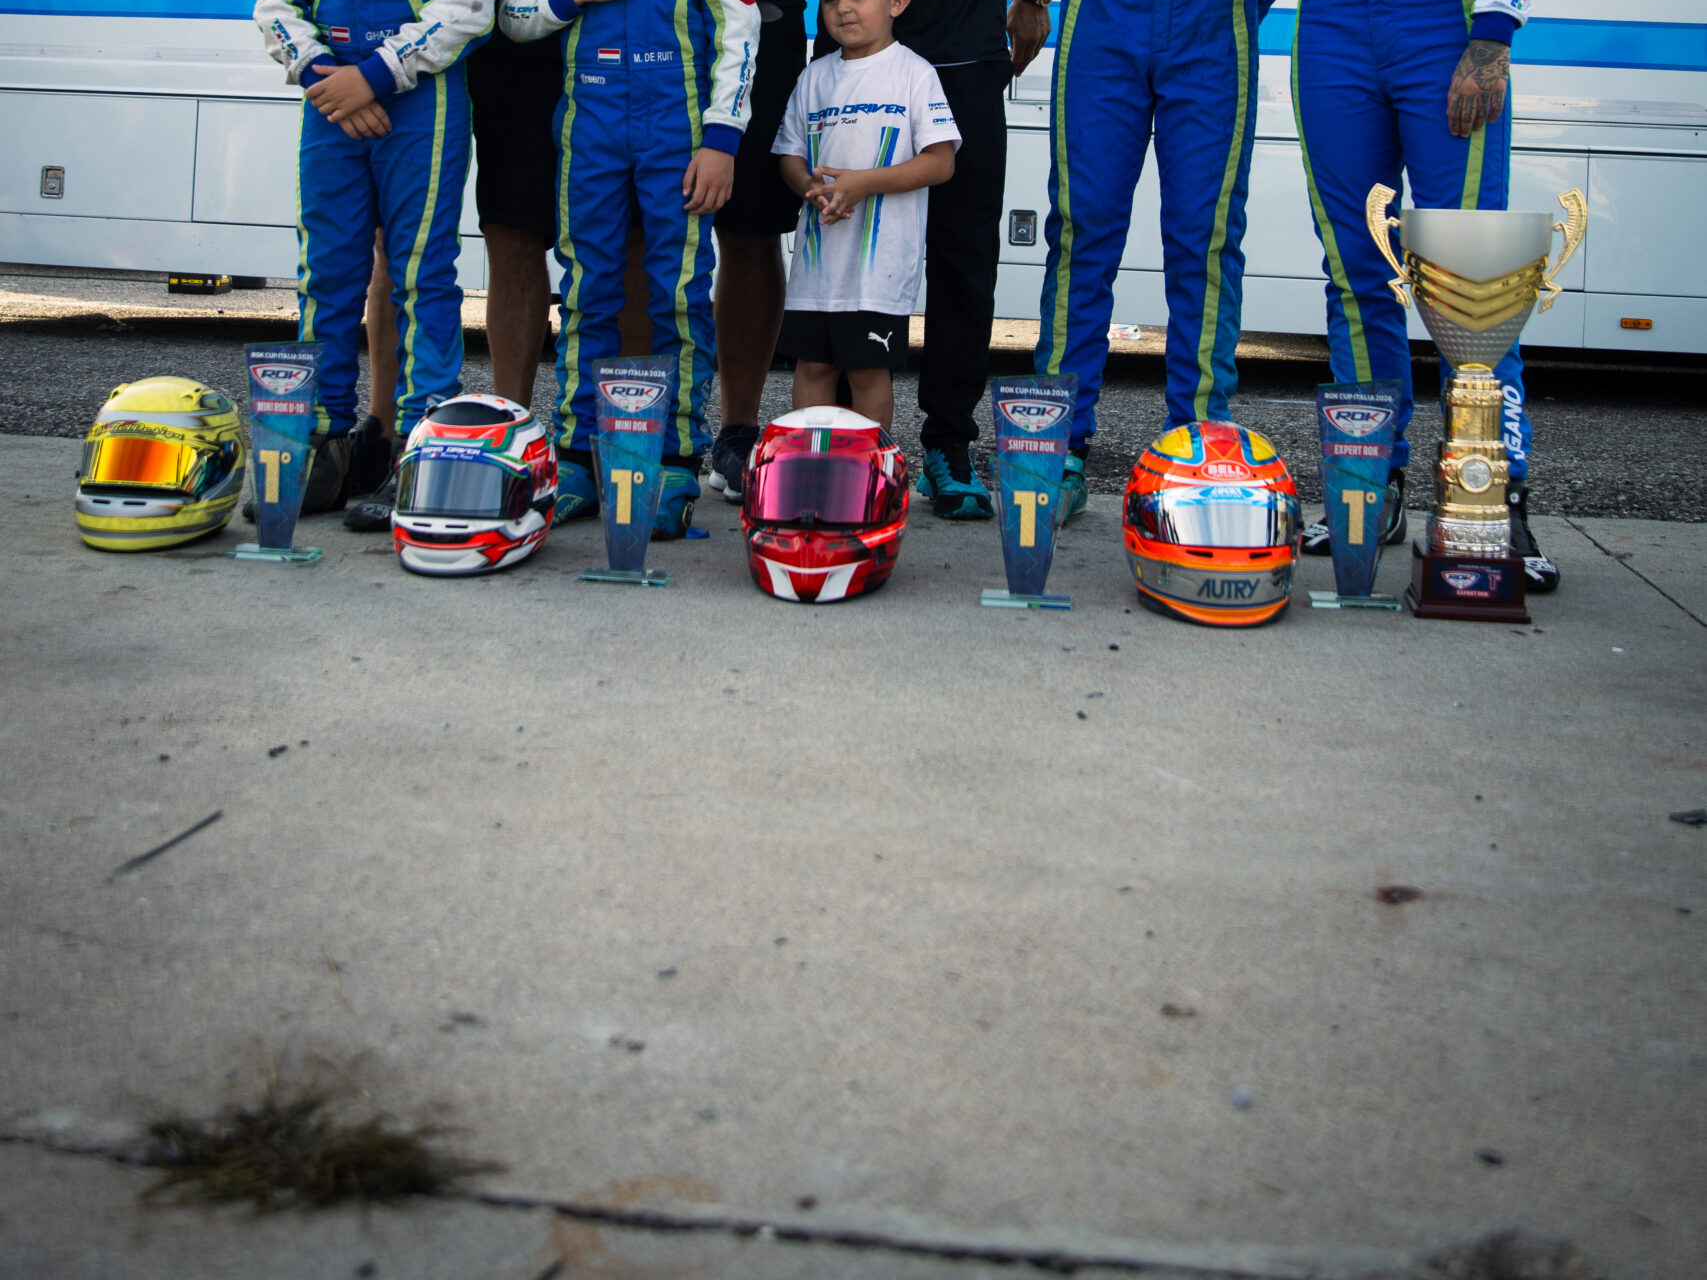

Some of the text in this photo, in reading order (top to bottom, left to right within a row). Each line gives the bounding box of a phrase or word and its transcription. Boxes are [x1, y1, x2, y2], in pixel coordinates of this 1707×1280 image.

[633, 51, 674, 63] M. DE RUIT
[841, 103, 906, 118] DRIVER
[251, 351, 265, 359] ROK
[261, 369, 303, 380] ROK
[600, 367, 614, 375] ROK
[611, 386, 655, 397] ROK
[1000, 386, 1015, 394] ROK
[257, 401, 274, 412] MINI
[274, 402, 288, 412] ROK
[1010, 405, 1056, 416] ROK
[1335, 411, 1380, 421] ROK
[615, 419, 648, 431] MINI ROK
[1008, 438, 1055, 453] SHIFTER ROK
[1334, 444, 1378, 457] EXPERT ROK
[1207, 463, 1244, 475] BELL
[1197, 578, 1260, 599] AUTRY
